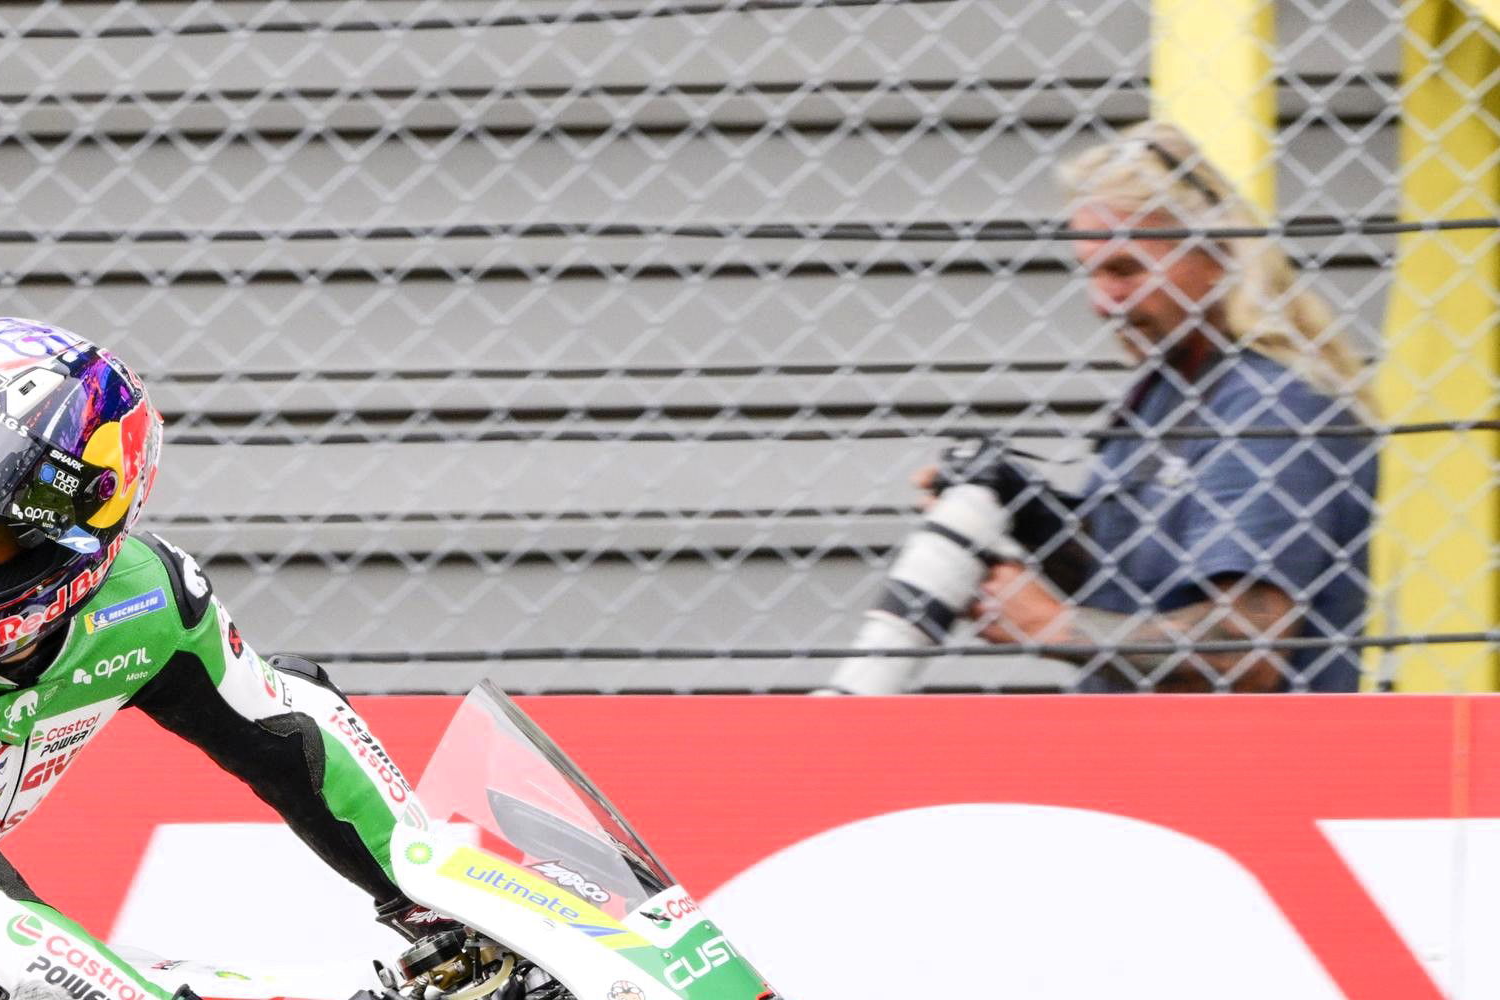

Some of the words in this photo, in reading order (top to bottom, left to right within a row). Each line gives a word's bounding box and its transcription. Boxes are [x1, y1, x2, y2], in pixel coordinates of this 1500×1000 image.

[50, 449, 85, 472] SHARK
[52, 480, 78, 498] LOCK
[55, 470, 80, 489] QUAD
[24, 506, 57, 523] april
[109, 596, 159, 620] MICHELIN
[94, 647, 152, 679] april
[125, 670, 150, 683] Moto
[46, 712, 101, 742] Castrol
[466, 866, 580, 920] ultimate
